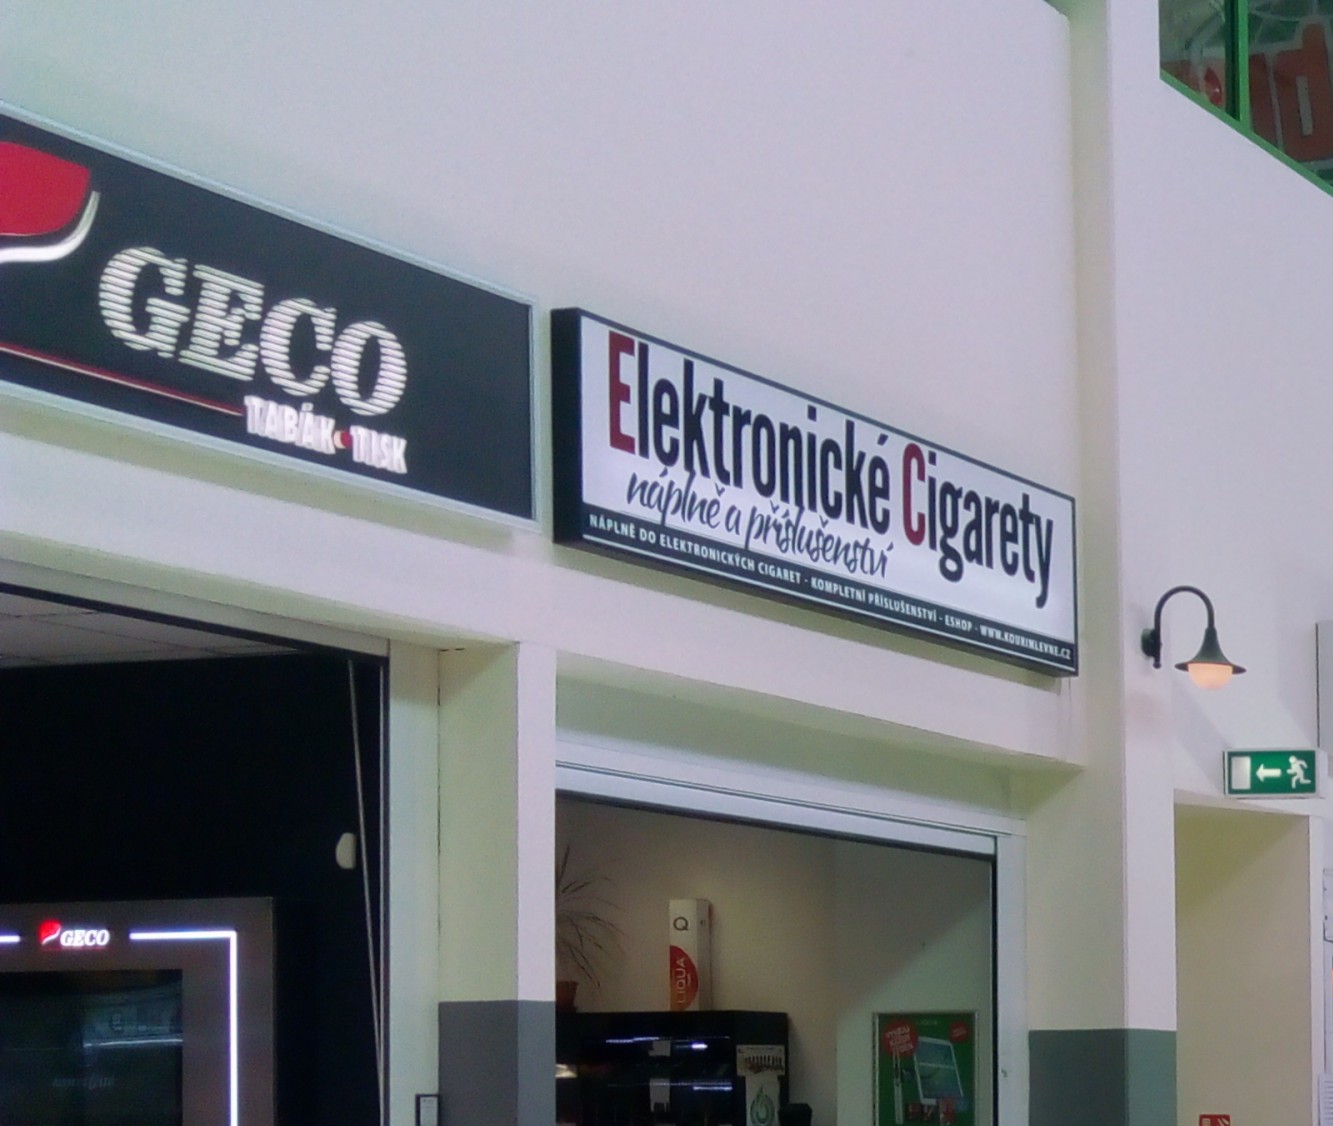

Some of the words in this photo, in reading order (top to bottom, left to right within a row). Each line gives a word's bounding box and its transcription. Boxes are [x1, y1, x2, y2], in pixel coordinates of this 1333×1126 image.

[99, 247, 407, 416] GECO
[244, 396, 336, 455] TABÁK
[351, 425, 408, 474] TISK
[609, 331, 890, 535] Elektronické
[903, 443, 1054, 608] Cigarety
[589, 514, 636, 539] NÁPLNĚ
[639, 527, 657, 544] DO
[660, 533, 755, 571] ELEKTRONICKÝCH
[758, 562, 801, 584] CIGARET
[811, 578, 866, 603] KOMPLETNÍ
[868, 591, 938, 623] PŘÍSLUŠENSTVÍ
[945, 615, 973, 632] ESHOP
[627, 467, 721, 528] náplně
[725, 509, 740, 535] a
[744, 500, 894, 578] příslušenství
[60, 929, 110, 948] GECO
[675, 957, 686, 1004] LIQUA
